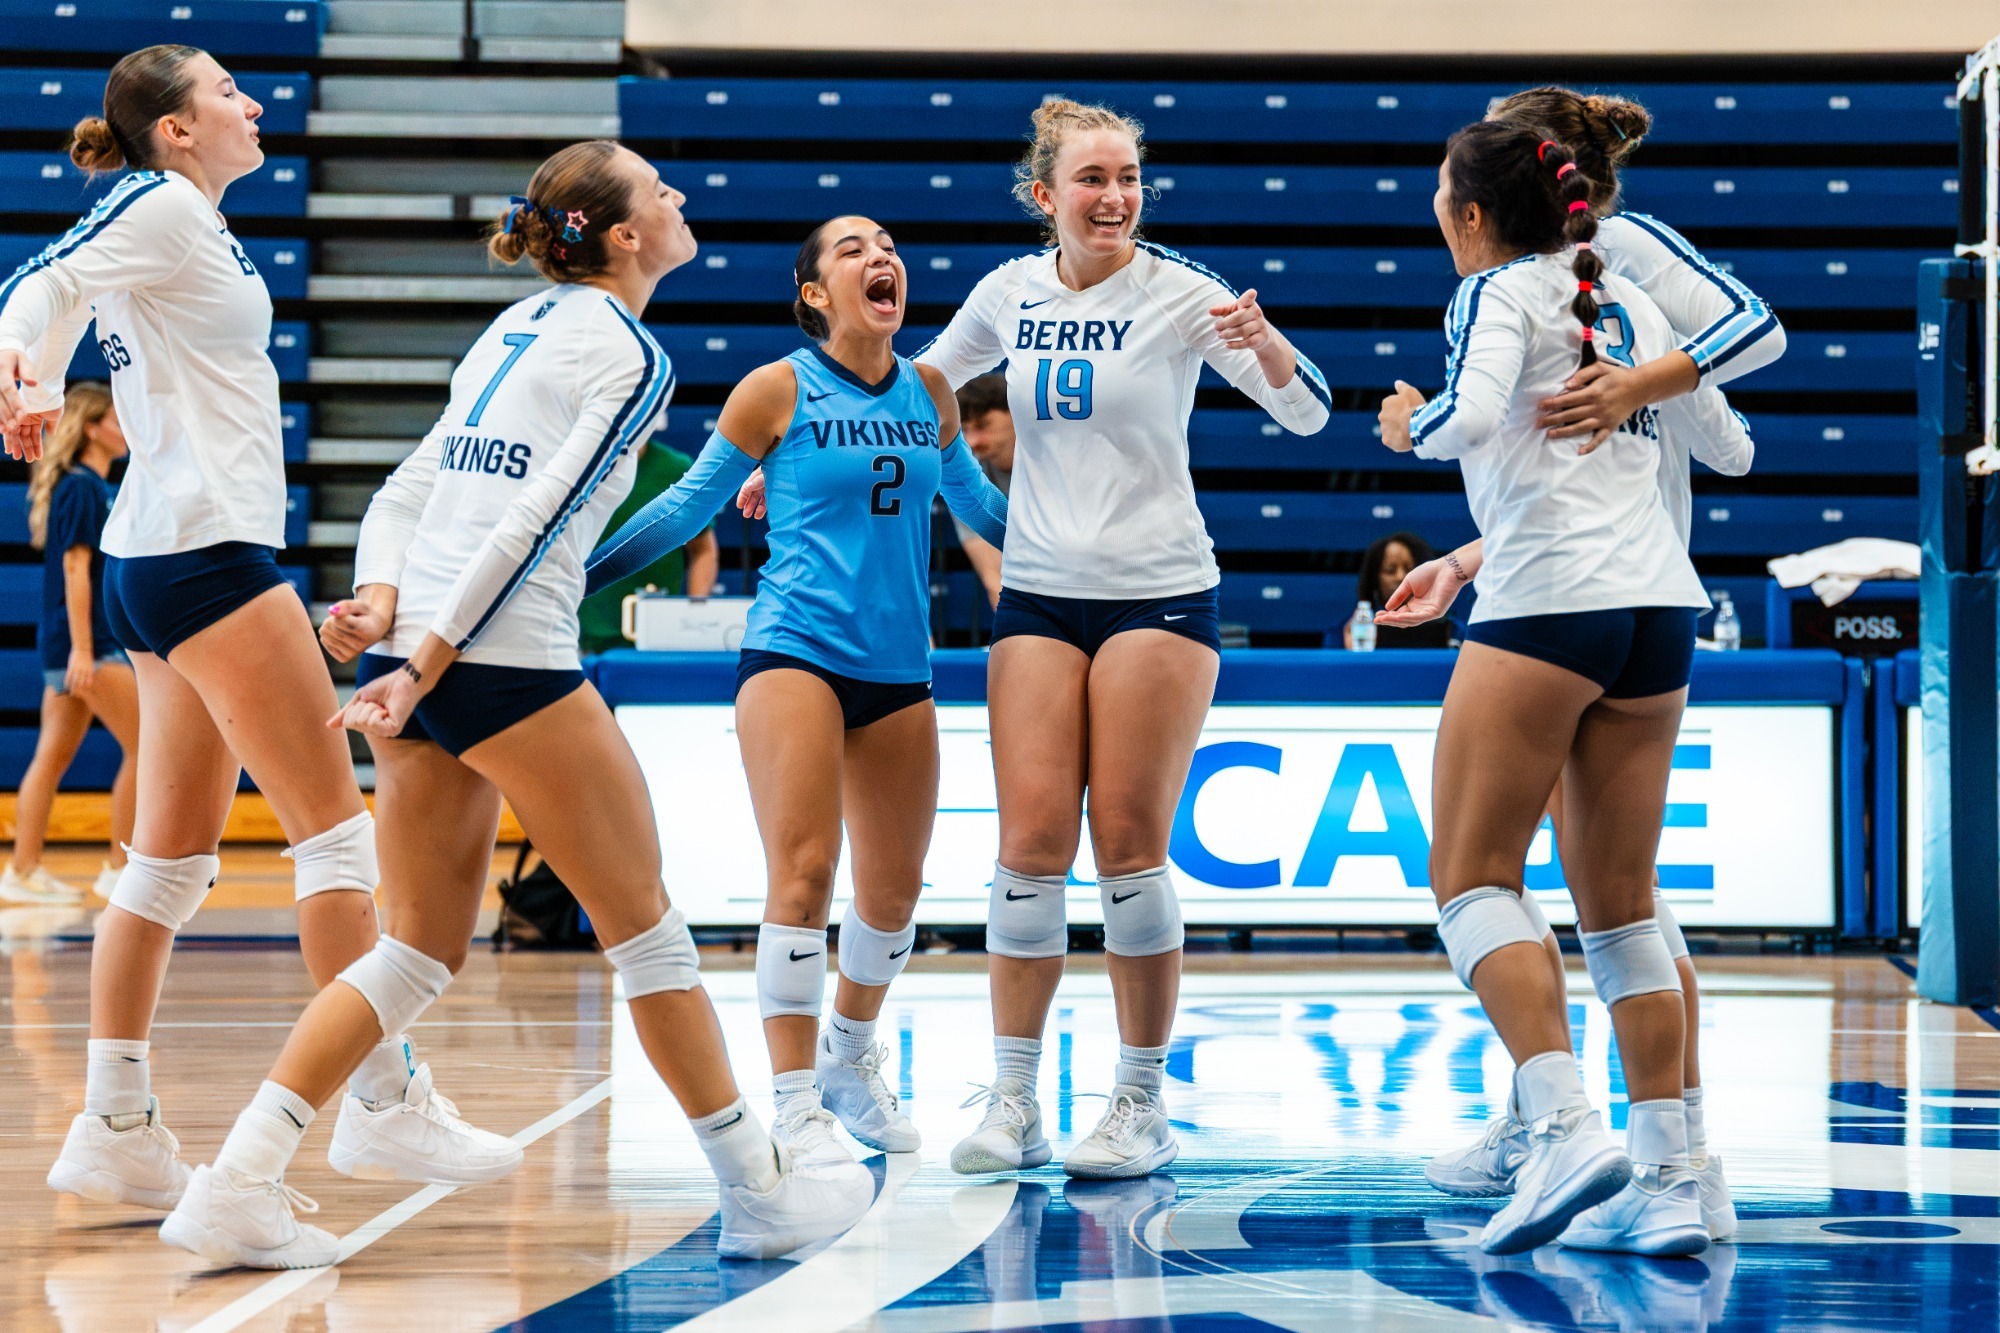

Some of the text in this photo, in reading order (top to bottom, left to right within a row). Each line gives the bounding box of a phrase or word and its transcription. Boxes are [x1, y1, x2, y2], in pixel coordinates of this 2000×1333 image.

[1015, 319, 1134, 351] BERRY
[465, 333, 539, 427] 7
[1035, 358, 1094, 421] 19
[809, 419, 940, 449] VIKINGS
[439, 435, 532, 480] IKINGS
[870, 454, 906, 517] 2
[1834, 616, 1902, 639] POSS.
